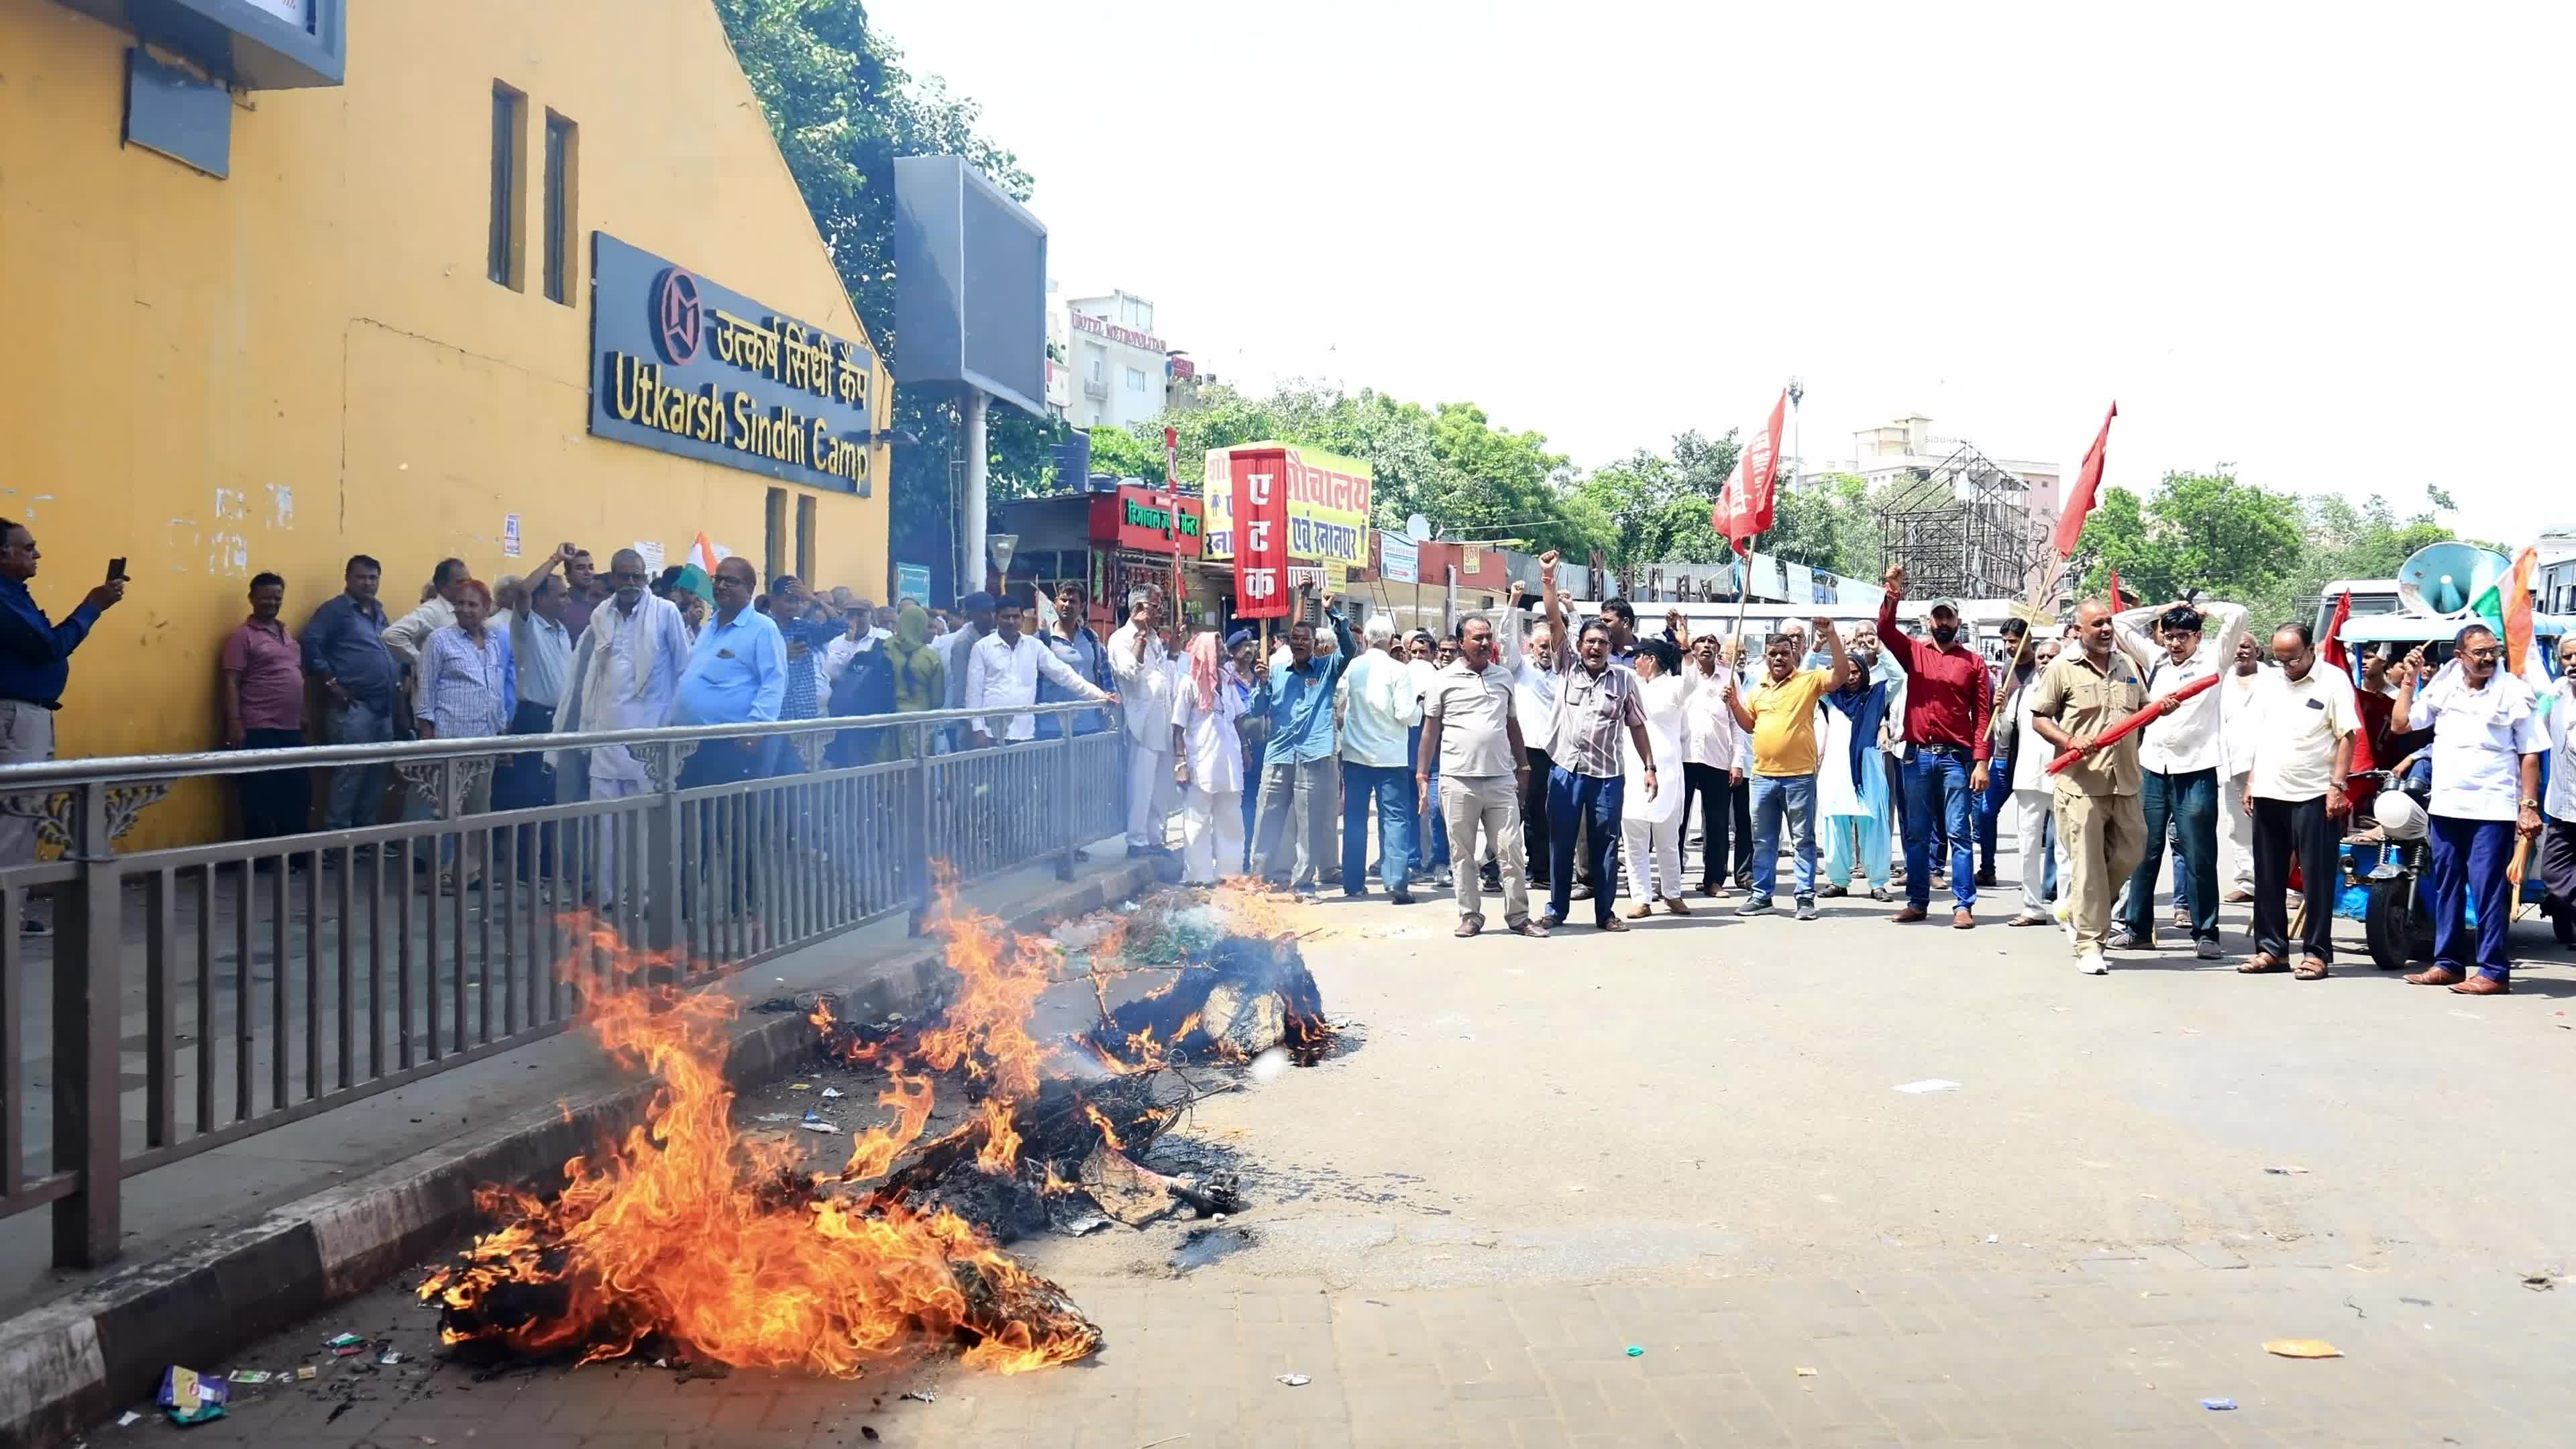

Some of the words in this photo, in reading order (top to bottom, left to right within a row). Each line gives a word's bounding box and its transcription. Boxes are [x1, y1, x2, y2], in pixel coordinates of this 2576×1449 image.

[716, 309, 780, 380] उत्कर्ष
[784, 321, 833, 397] सिंधी
[839, 341, 870, 411] कैंप
[1073, 313, 1104, 333] HOTEL
[1106, 324, 1166, 353] METROPOLITAN
[616, 351, 726, 444] Utkarsh
[735, 391, 806, 466] Sindhi
[812, 418, 869, 494] Camp
[1292, 510, 1312, 553] एवं
[1314, 521, 1357, 560] स्नानघर
